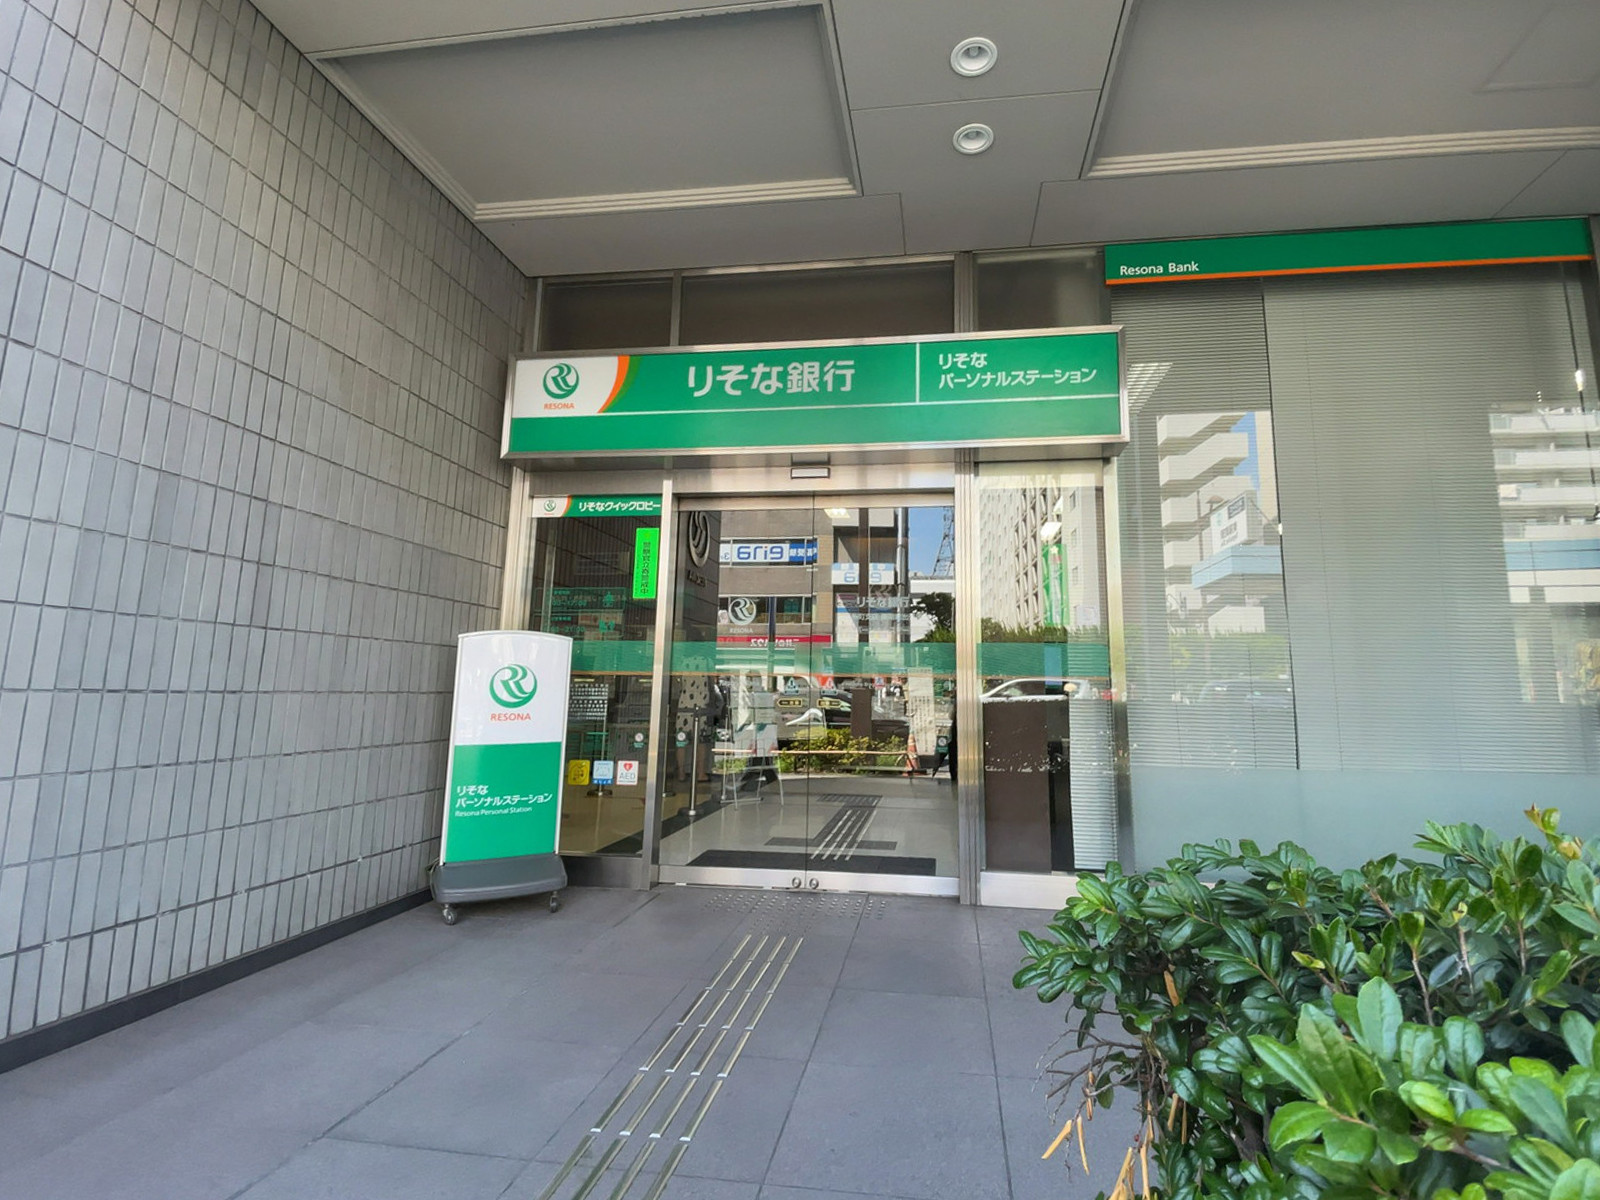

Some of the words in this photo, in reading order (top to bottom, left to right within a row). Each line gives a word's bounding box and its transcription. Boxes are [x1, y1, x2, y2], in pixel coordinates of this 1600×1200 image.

[1120, 263, 1163, 276] Resona
[1168, 260, 1199, 273] Bank
[938, 352, 988, 370] りそな
[687, 359, 856, 397] りそな銀行
[938, 367, 1097, 390] パーソナルステーション
[543, 402, 575, 410] RESONA
[490, 712, 531, 722] RESONA
[619, 772, 636, 780] AED
[457, 785, 488, 795] りそな
[455, 793, 553, 808] パーソナルステーション
[480, 807, 510, 816] Personal
[510, 805, 533, 814] Station
